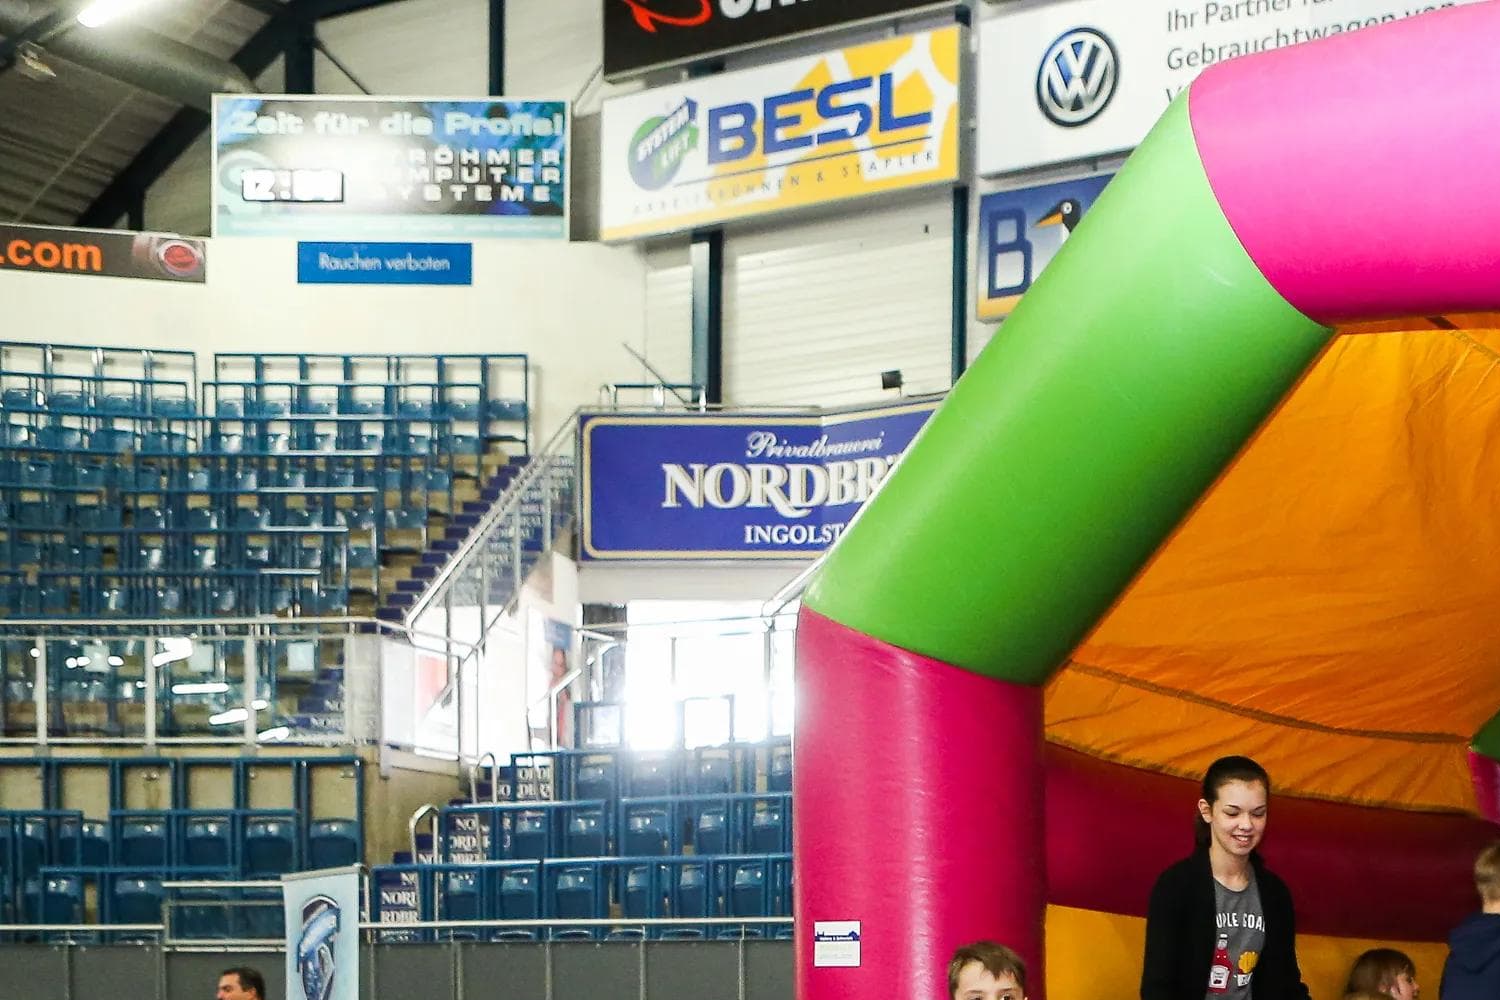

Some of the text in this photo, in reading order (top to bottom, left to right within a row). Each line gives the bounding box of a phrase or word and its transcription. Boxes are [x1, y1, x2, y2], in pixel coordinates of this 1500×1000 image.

[1166, 0, 1291, 33] Ihr Partner
[222, 111, 306, 136] Zeit
[313, 111, 371, 136] für
[382, 112, 433, 136] die
[707, 71, 933, 166] BESL
[317, 251, 452, 273] Rauchen verboten
[745, 431, 886, 458] Privatbrauerei
[661, 455, 902, 518] NORDBR
[744, 522, 848, 546] INGOLST
